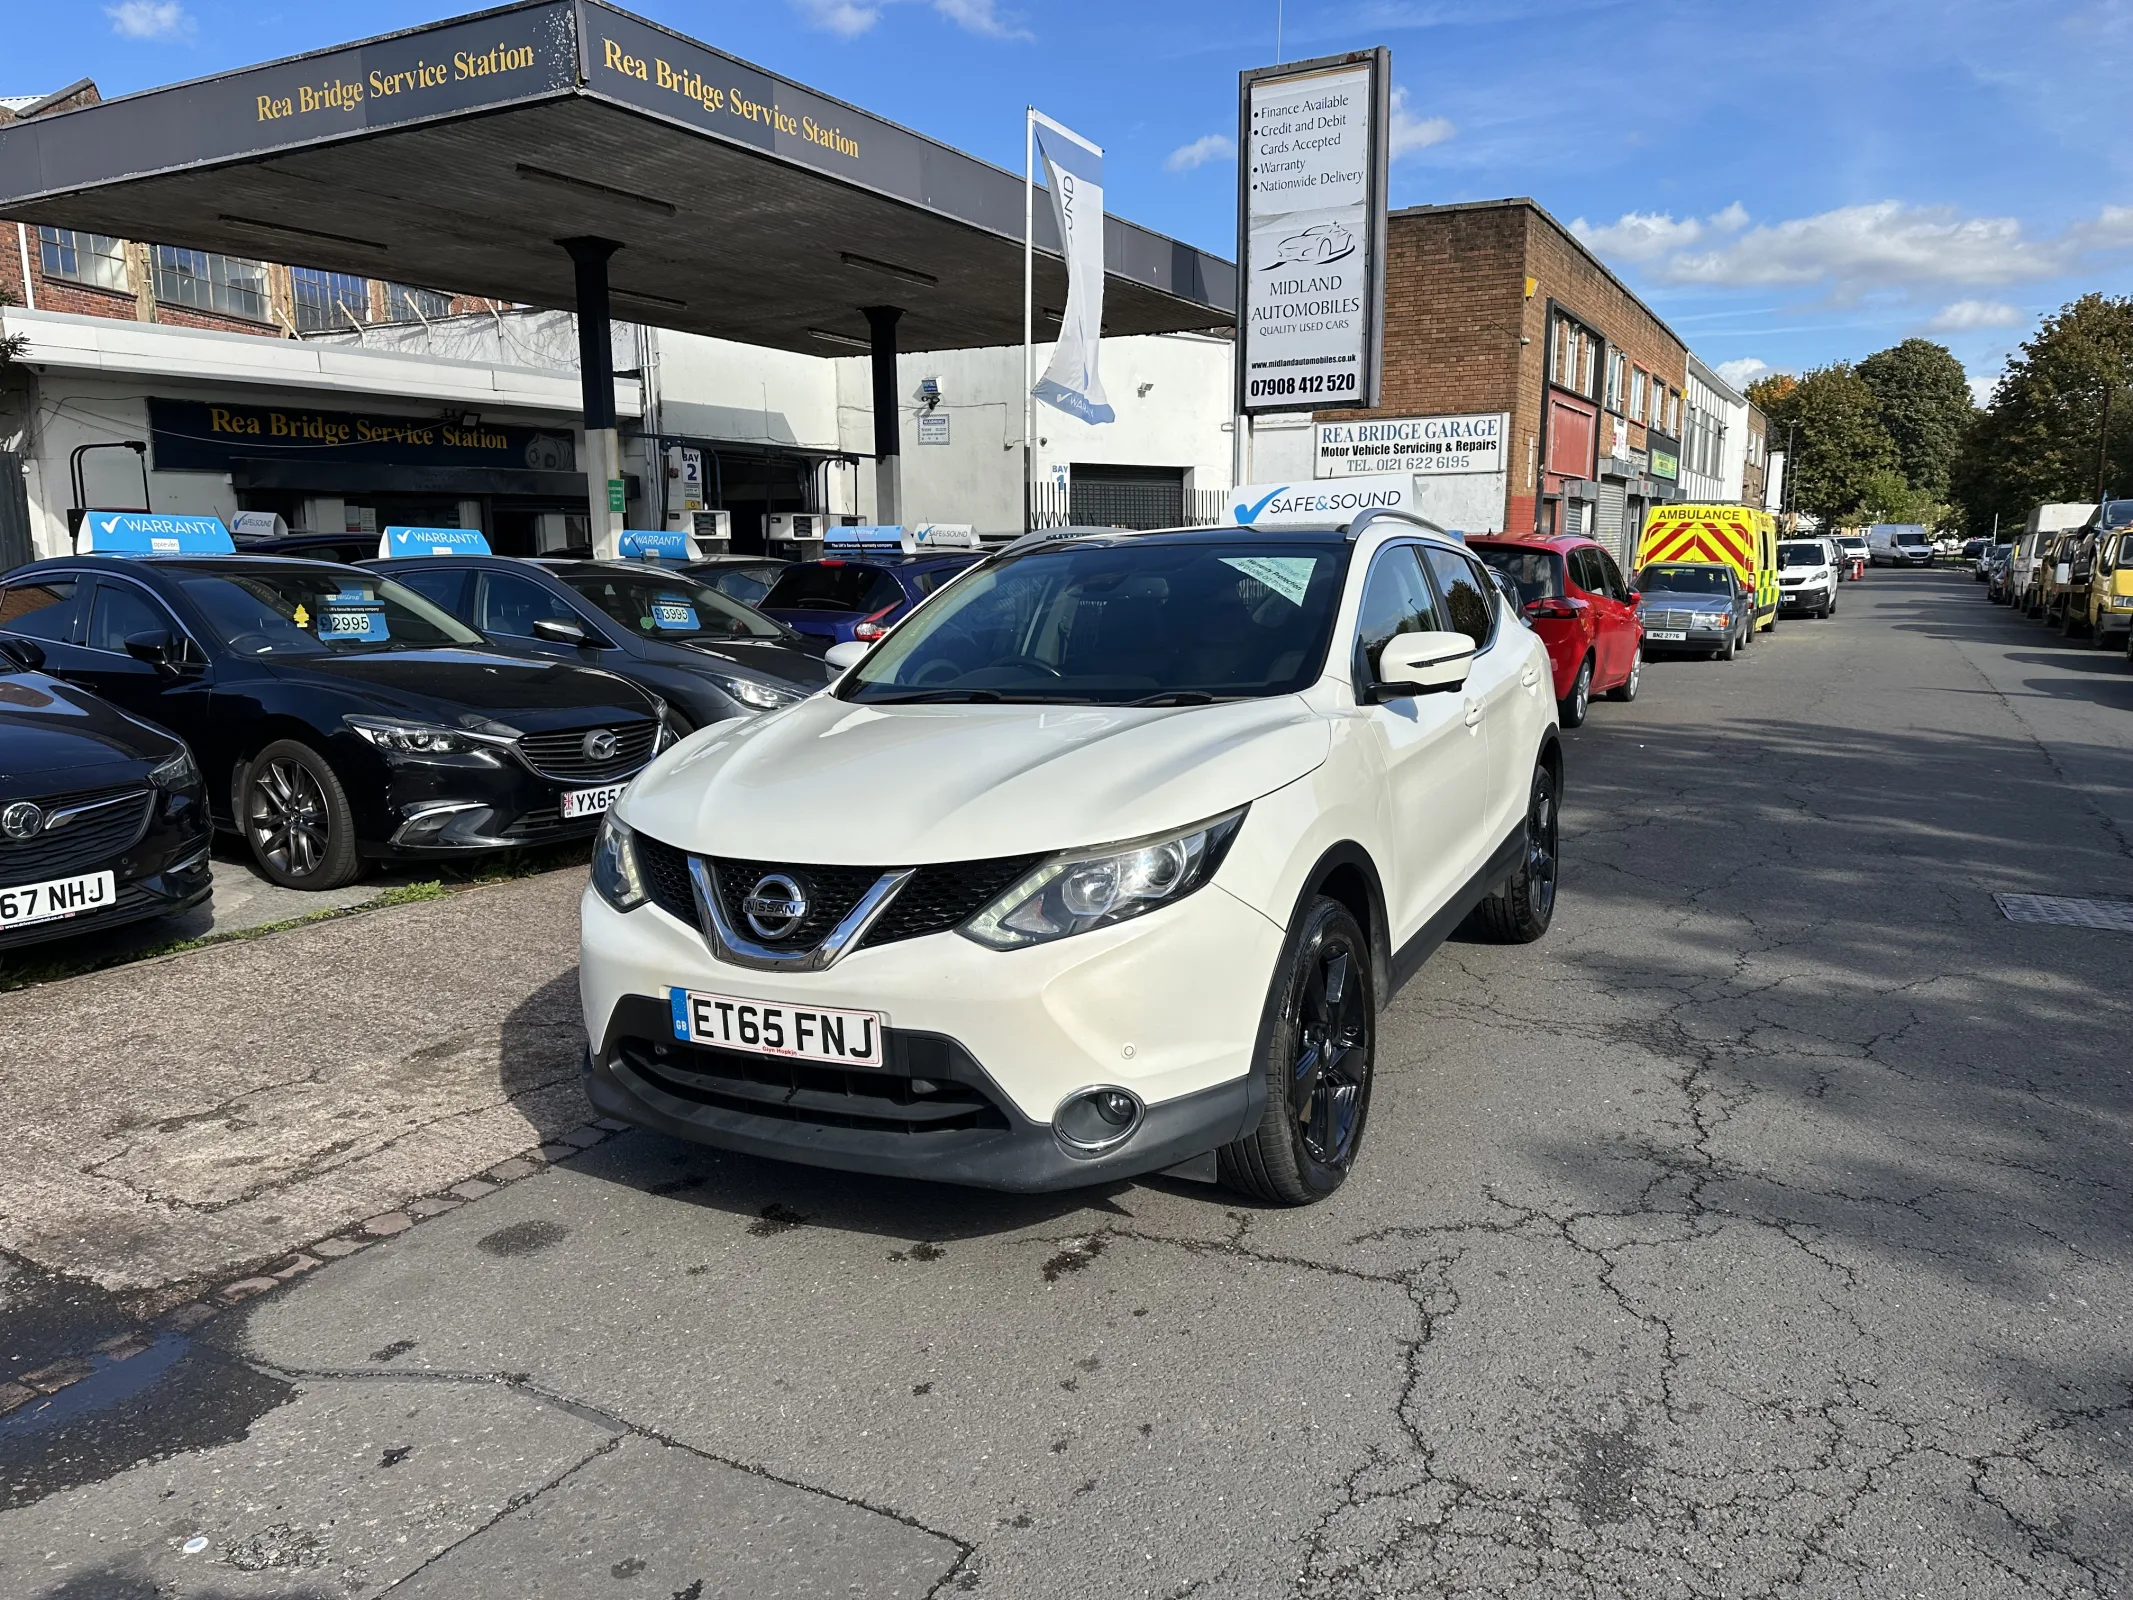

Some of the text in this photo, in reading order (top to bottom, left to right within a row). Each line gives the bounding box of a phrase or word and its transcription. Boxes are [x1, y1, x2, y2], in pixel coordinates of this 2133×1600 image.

[256, 42, 535, 121] Rea Bridge Service Station
[602, 37, 859, 158] Rea Bridge Service Station
[1261, 94, 1349, 118] Finance Available
[1260, 114, 1347, 137] Credit and Debit
[1260, 133, 1341, 155] Cards Accepted
[1260, 159, 1306, 174] Warranty
[1260, 170, 1364, 192] Nationwide Delivery
[1270, 275, 1342, 296] MIDLAND
[1251, 297, 1360, 321] AUTOMOBILES
[1260, 319, 1349, 336] QUALITY USED CARS
[1251, 354, 1356, 369] www.midlandautomobiles.co.uk
[1250, 373, 1355, 397] 07908 412 520
[210, 408, 508, 449] Rea Bridge Service Station
[1322, 419, 1498, 444] REA BRIDGE GARAGE
[1321, 439, 1497, 457] Motor Vehicle Servicing & Repairs
[682, 453, 699, 462] BAY
[1347, 455, 1470, 472] TEL. 0121 622 6195
[687, 463, 697, 481] 2
[1052, 465, 1068, 473] BAY
[1056, 474, 1064, 490] 1
[1269, 490, 1401, 514] SAFE&SOUND
[241, 519, 272, 527] SAFE&SOUND
[1658, 510, 1740, 521] AMBULANCE
[123, 518, 216, 535] WARRANTY
[928, 530, 968, 538] SAFE&SOUND
[412, 532, 479, 544] WARRANTY
[635, 535, 682, 546] WARRANTY
[576, 789, 616, 812] YX65
[0, 877, 104, 919] 67 NHJ
[746, 900, 796, 915] NISSAN
[676, 1019, 687, 1032] GB
[692, 998, 873, 1059] ET65 FNJ
[762, 1046, 776, 1054] Glyn
